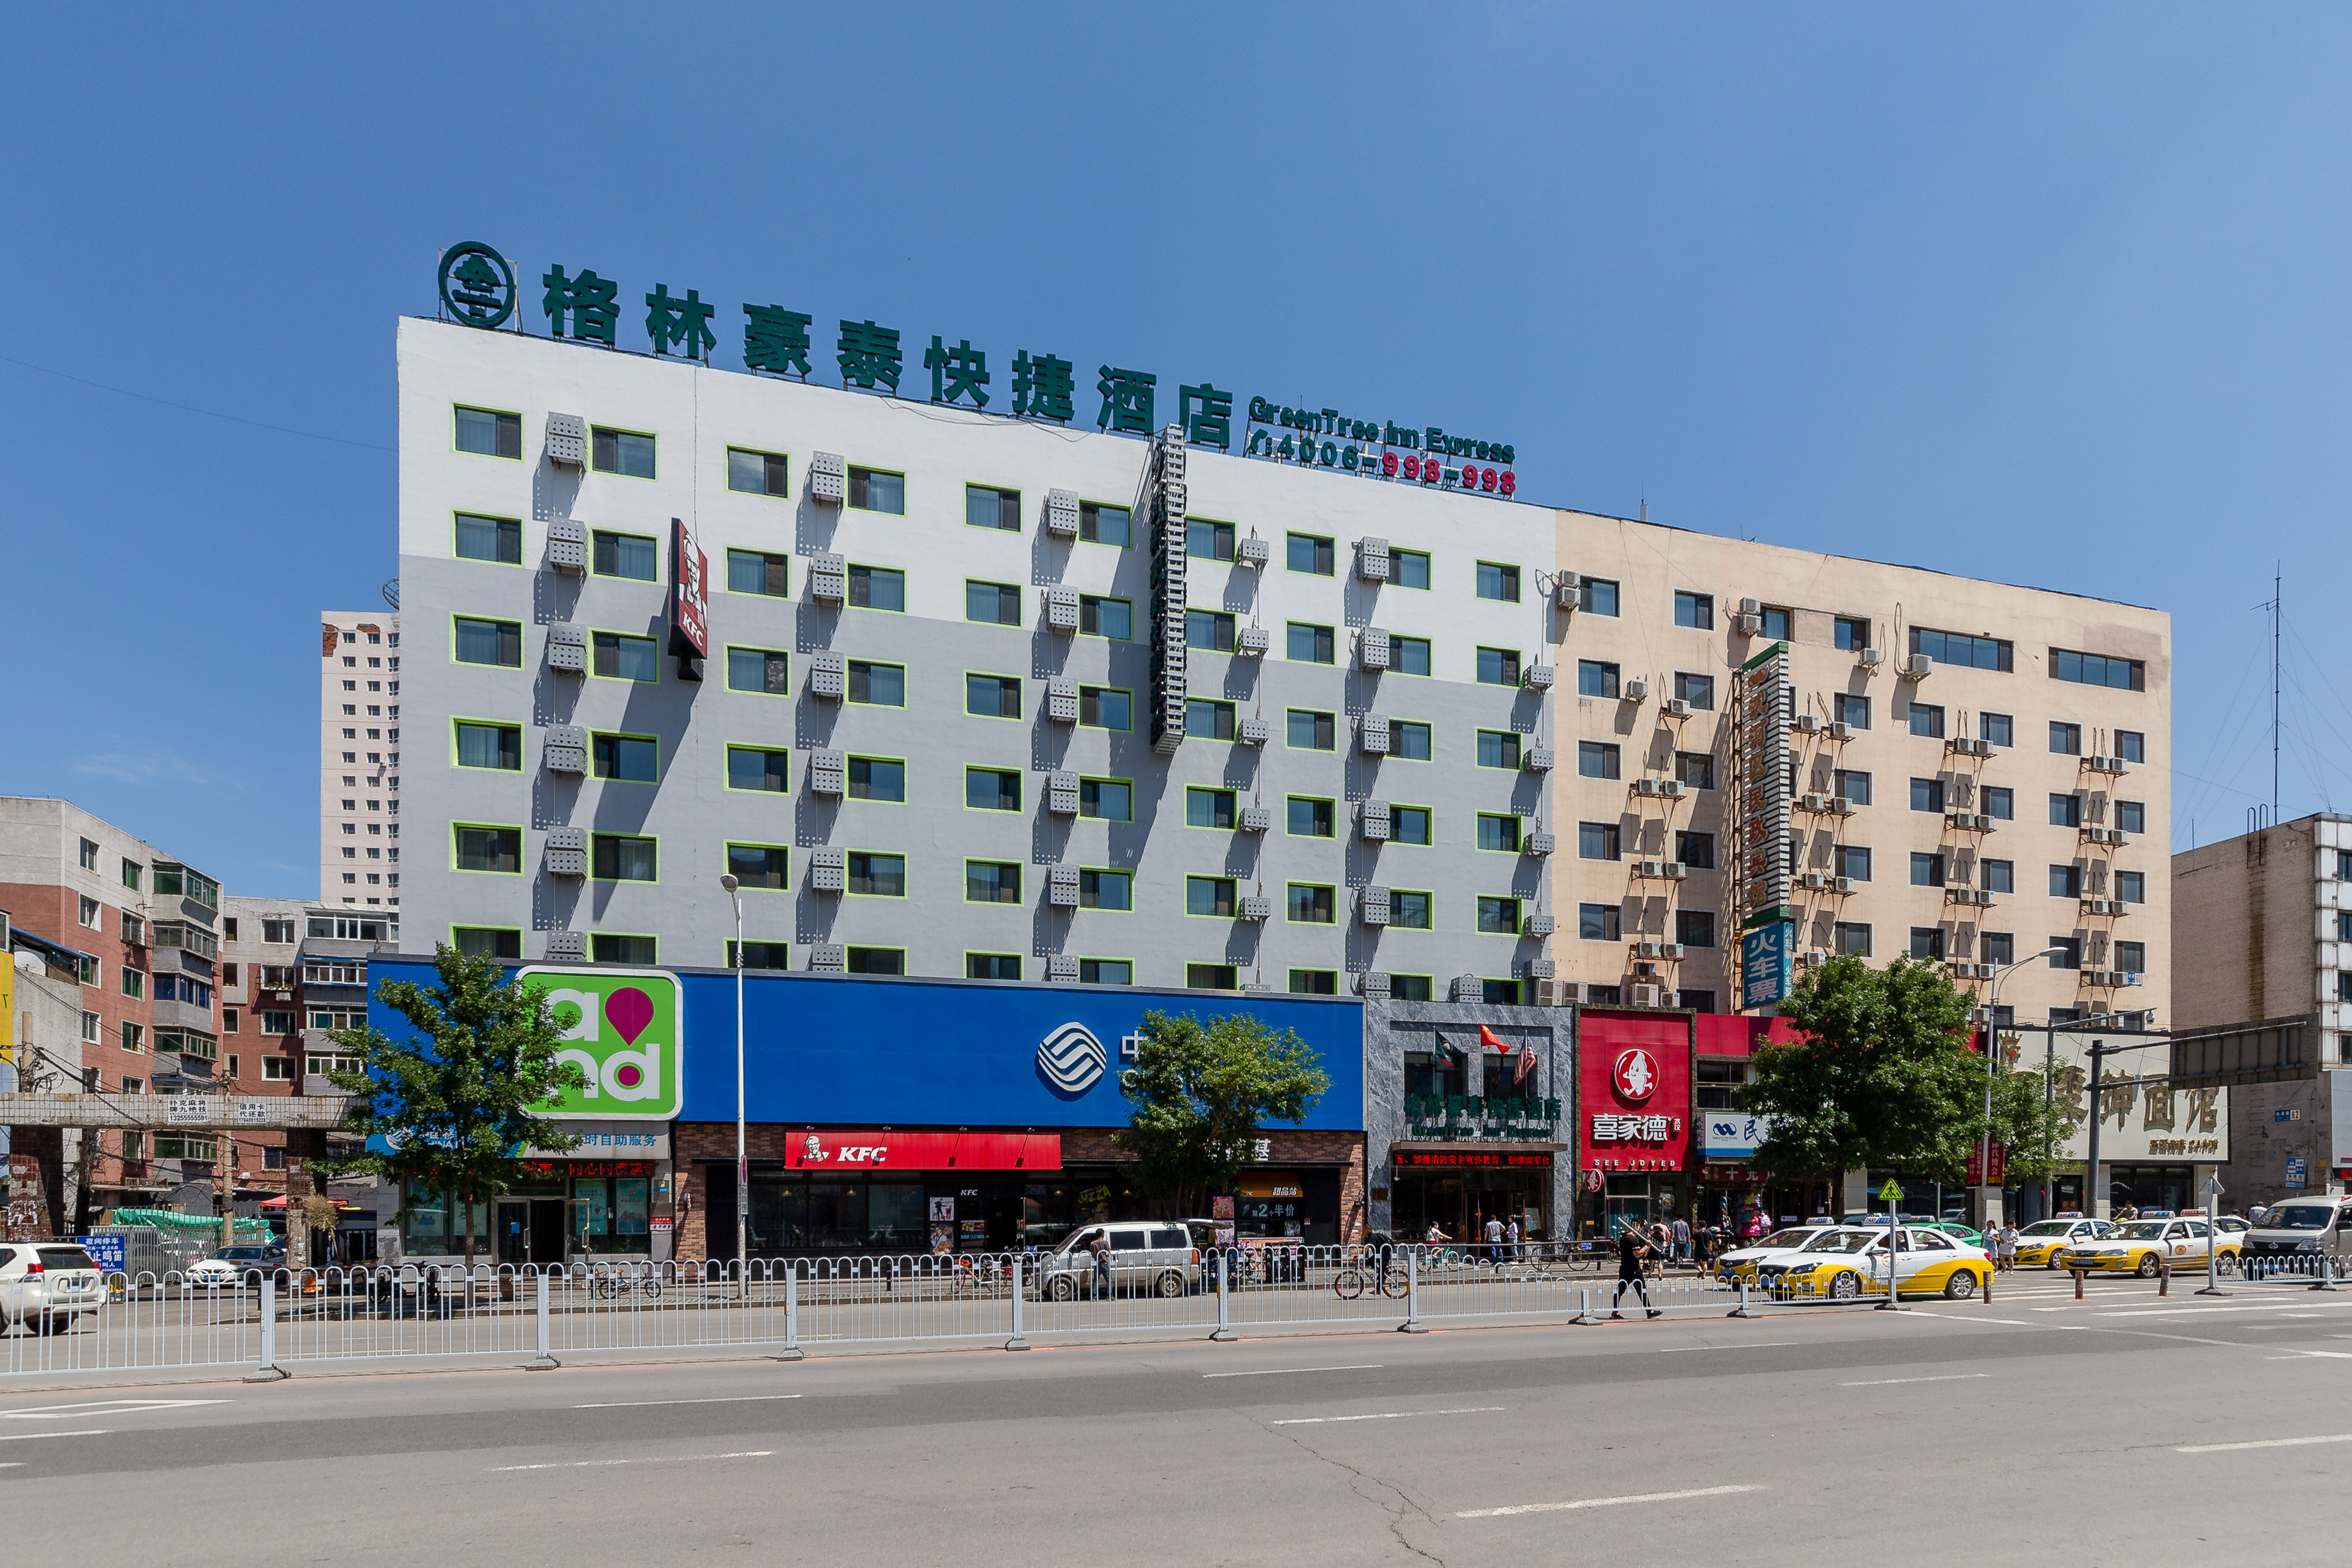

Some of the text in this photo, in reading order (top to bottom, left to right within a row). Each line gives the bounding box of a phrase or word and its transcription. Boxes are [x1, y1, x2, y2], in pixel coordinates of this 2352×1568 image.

[542, 263, 1233, 449] 格林豪泰快捷酒店
[1249, 396, 1516, 463] GreenTree Inn Express
[682, 611, 704, 647] KFC
[1748, 933, 1779, 1004] 火车票
[1404, 1094, 1562, 1120] 格林豪泰快捷酒店
[2291, 1111, 2299, 1119] 62
[1412, 1122, 1551, 1139] GreenTree Inn Express
[1593, 1113, 1669, 1141] 喜家德
[573, 1134, 657, 1147] 时自助服务
[837, 1146, 887, 1162] KFC
[1272, 1187, 1297, 1196] 甜品站
